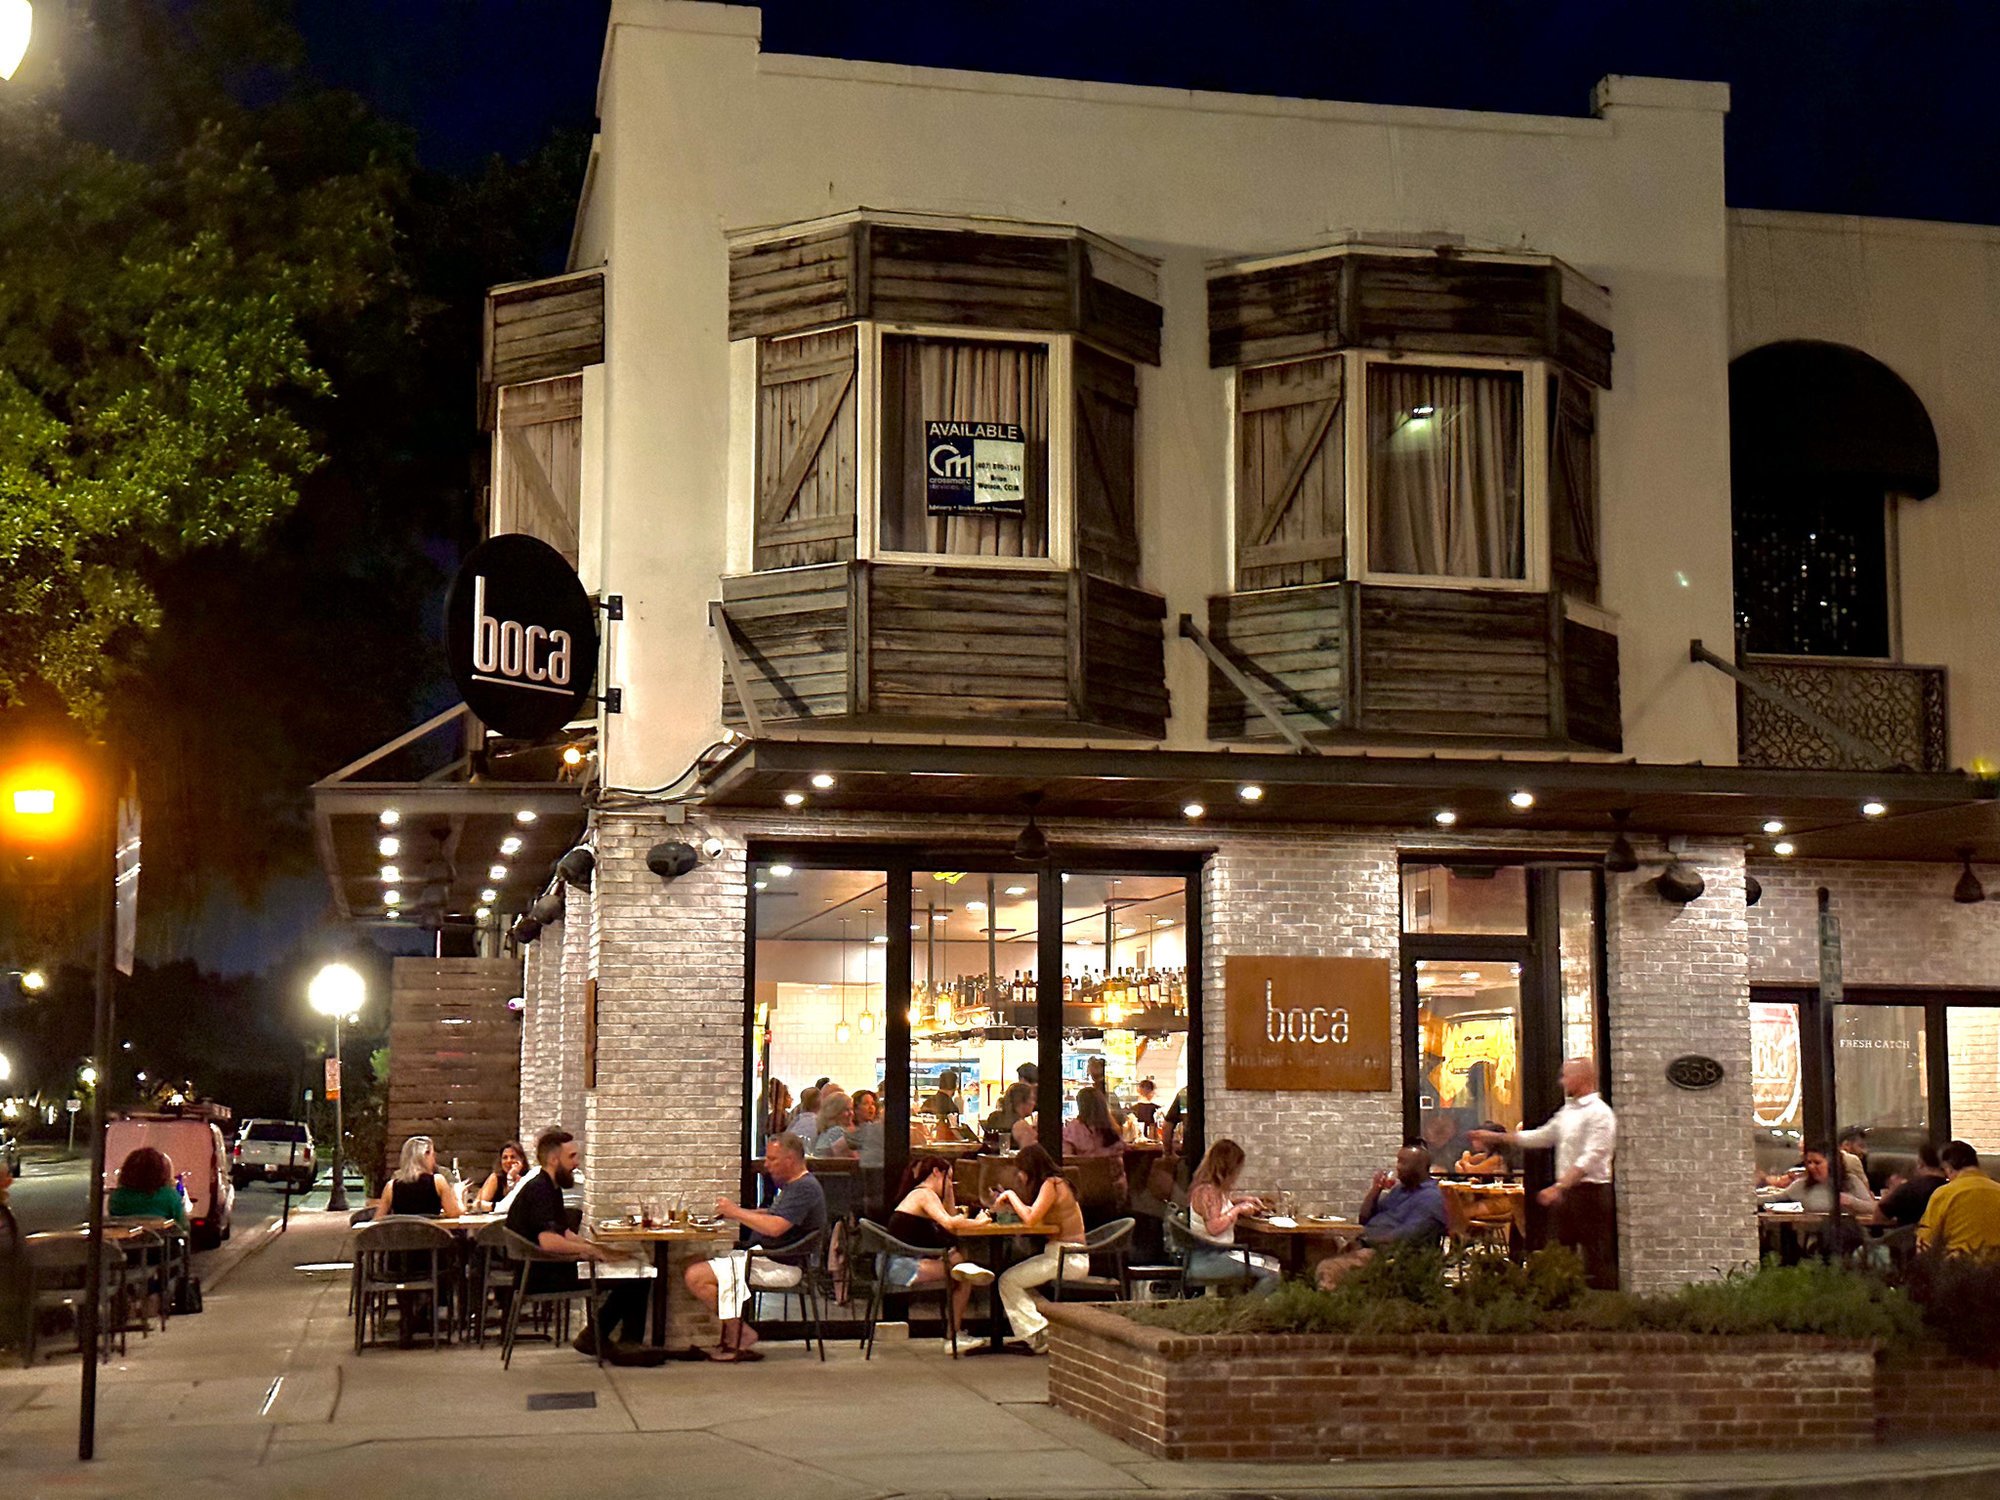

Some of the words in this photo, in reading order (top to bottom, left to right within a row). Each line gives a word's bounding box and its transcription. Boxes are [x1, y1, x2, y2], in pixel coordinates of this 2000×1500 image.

[929, 422, 1018, 440] AVAILABLE
[473, 575, 572, 686] boca
[1265, 977, 1349, 1044] boca
[1839, 1038, 1872, 1049] FRESH
[1874, 1039, 1911, 1050] CATCH
